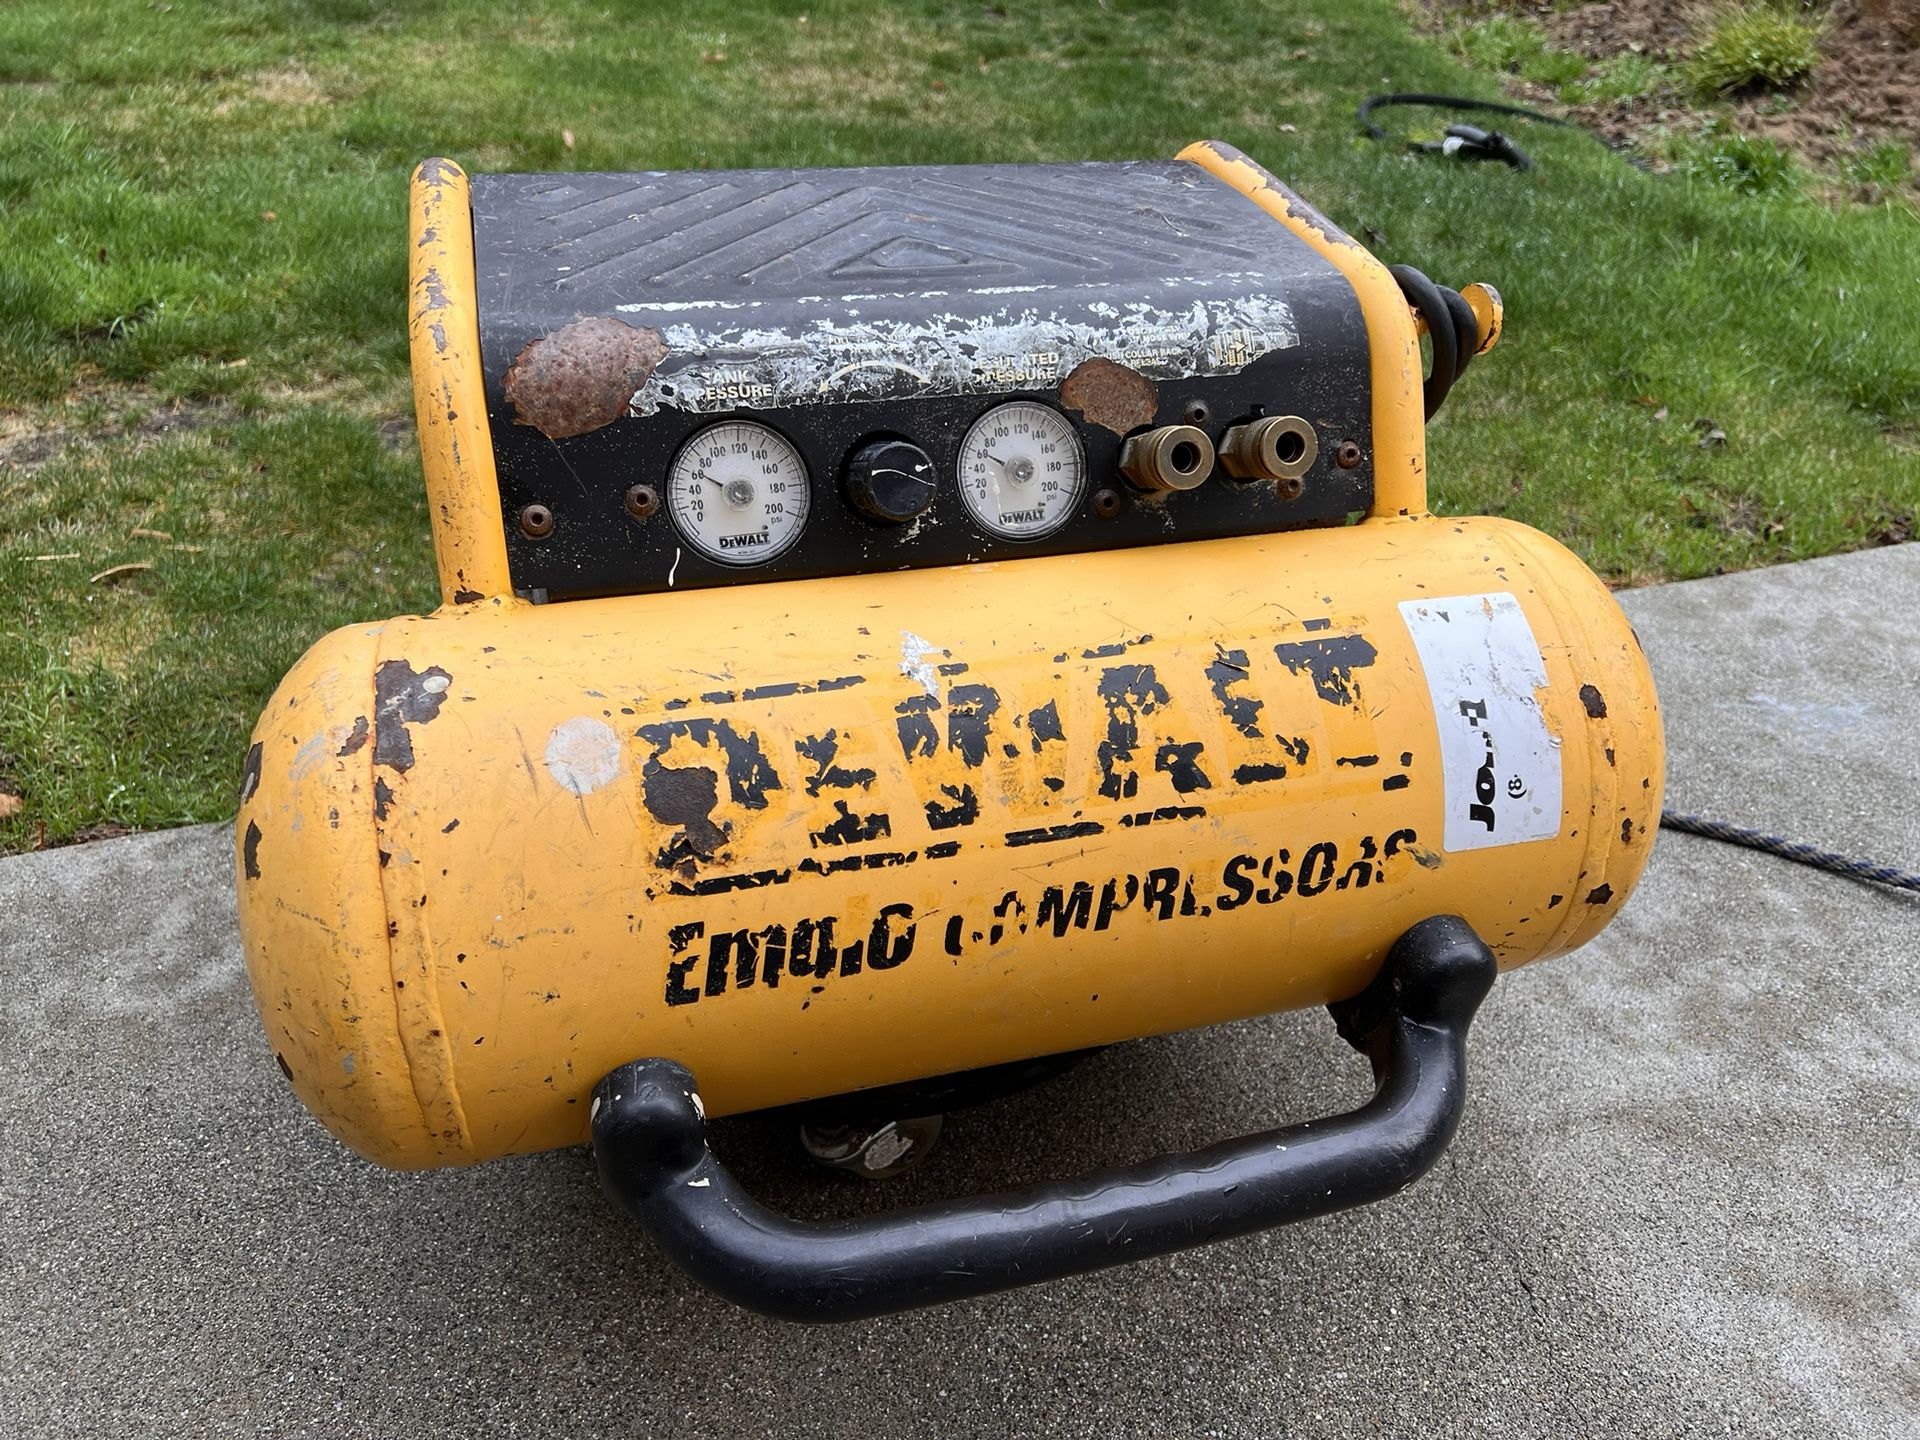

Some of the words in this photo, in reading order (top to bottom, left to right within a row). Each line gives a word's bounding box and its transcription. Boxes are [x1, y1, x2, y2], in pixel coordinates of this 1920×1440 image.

[994, 427, 1009, 438] 100
[1014, 423, 1029, 434] 120
[1032, 430, 1047, 440] 140
[984, 437, 996, 448] 80
[710, 446, 726, 458] 100
[731, 443, 748, 455] 120
[977, 449, 988, 459] 60
[1040, 444, 1055, 454] 160
[751, 450, 768, 461] 140
[700, 457, 712, 468] 80
[1047, 461, 1061, 472] 180
[763, 463, 778, 475] 160
[974, 463, 985, 474] 40
[691, 469, 704, 480] 60
[769, 483, 786, 494] 180
[975, 478, 987, 489] 20
[1041, 481, 1058, 492] 200
[689, 484, 701, 495] 40
[980, 490, 986, 500] 0
[691, 500, 704, 511] 20
[765, 503, 784, 515] 200
[697, 513, 704, 522] 0
